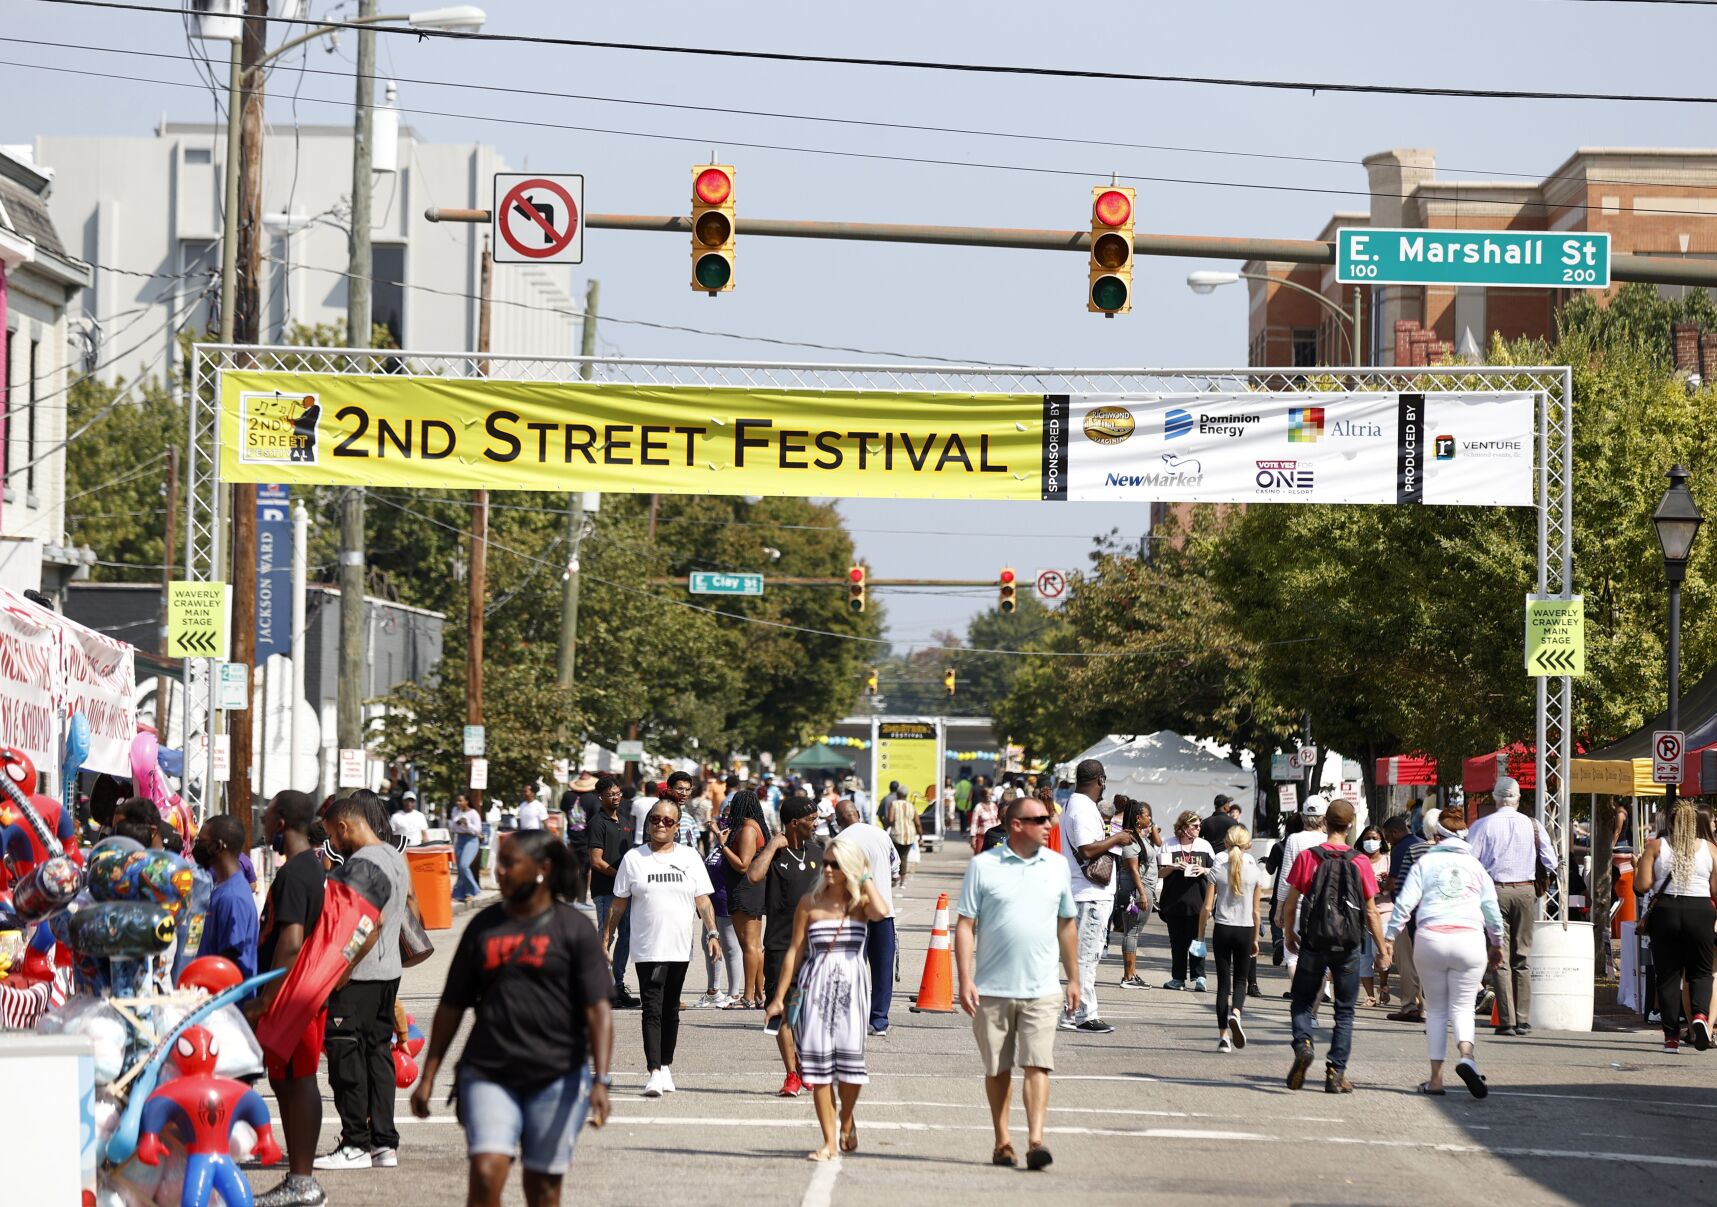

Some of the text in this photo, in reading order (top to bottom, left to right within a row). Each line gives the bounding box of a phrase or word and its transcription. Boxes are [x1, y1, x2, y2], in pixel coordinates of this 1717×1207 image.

[1350, 235, 1596, 266] E. Marshall St
[1350, 264, 1378, 277] 100
[1563, 269, 1596, 282] 200
[1092, 410, 1130, 420] RICHMOND
[1200, 414, 1260, 424] Dominion
[249, 417, 281, 431] 2ND
[1331, 420, 1382, 437] Altria
[1200, 425, 1245, 437] Energy
[249, 433, 308, 449] STREET
[333, 405, 1009, 473] 2ND STREET FESTIVAL
[1048, 401, 1060, 493] SPONSORED BY
[1404, 404, 1416, 492] PRODUCED BY
[1463, 441, 1521, 450] VENTURE
[246, 448, 308, 459] FESTIVAL
[1258, 461, 1279, 469] VOTE
[1280, 461, 1296, 469] YES
[1105, 472, 1204, 487] NewMarket
[1256, 470, 1314, 489] ONE
[259, 532, 274, 645] JACKSON WARD
[712, 576, 740, 589] Clay
[174, 590, 220, 599] WAVERLY
[173, 600, 221, 608] CRAWLEY
[1533, 609, 1578, 617] WAVERLY
[182, 618, 213, 626] STAGE
[1532, 618, 1579, 626] CRAWLEY
[1540, 637, 1572, 645] STAGE
[647, 872, 683, 884] PUMA
